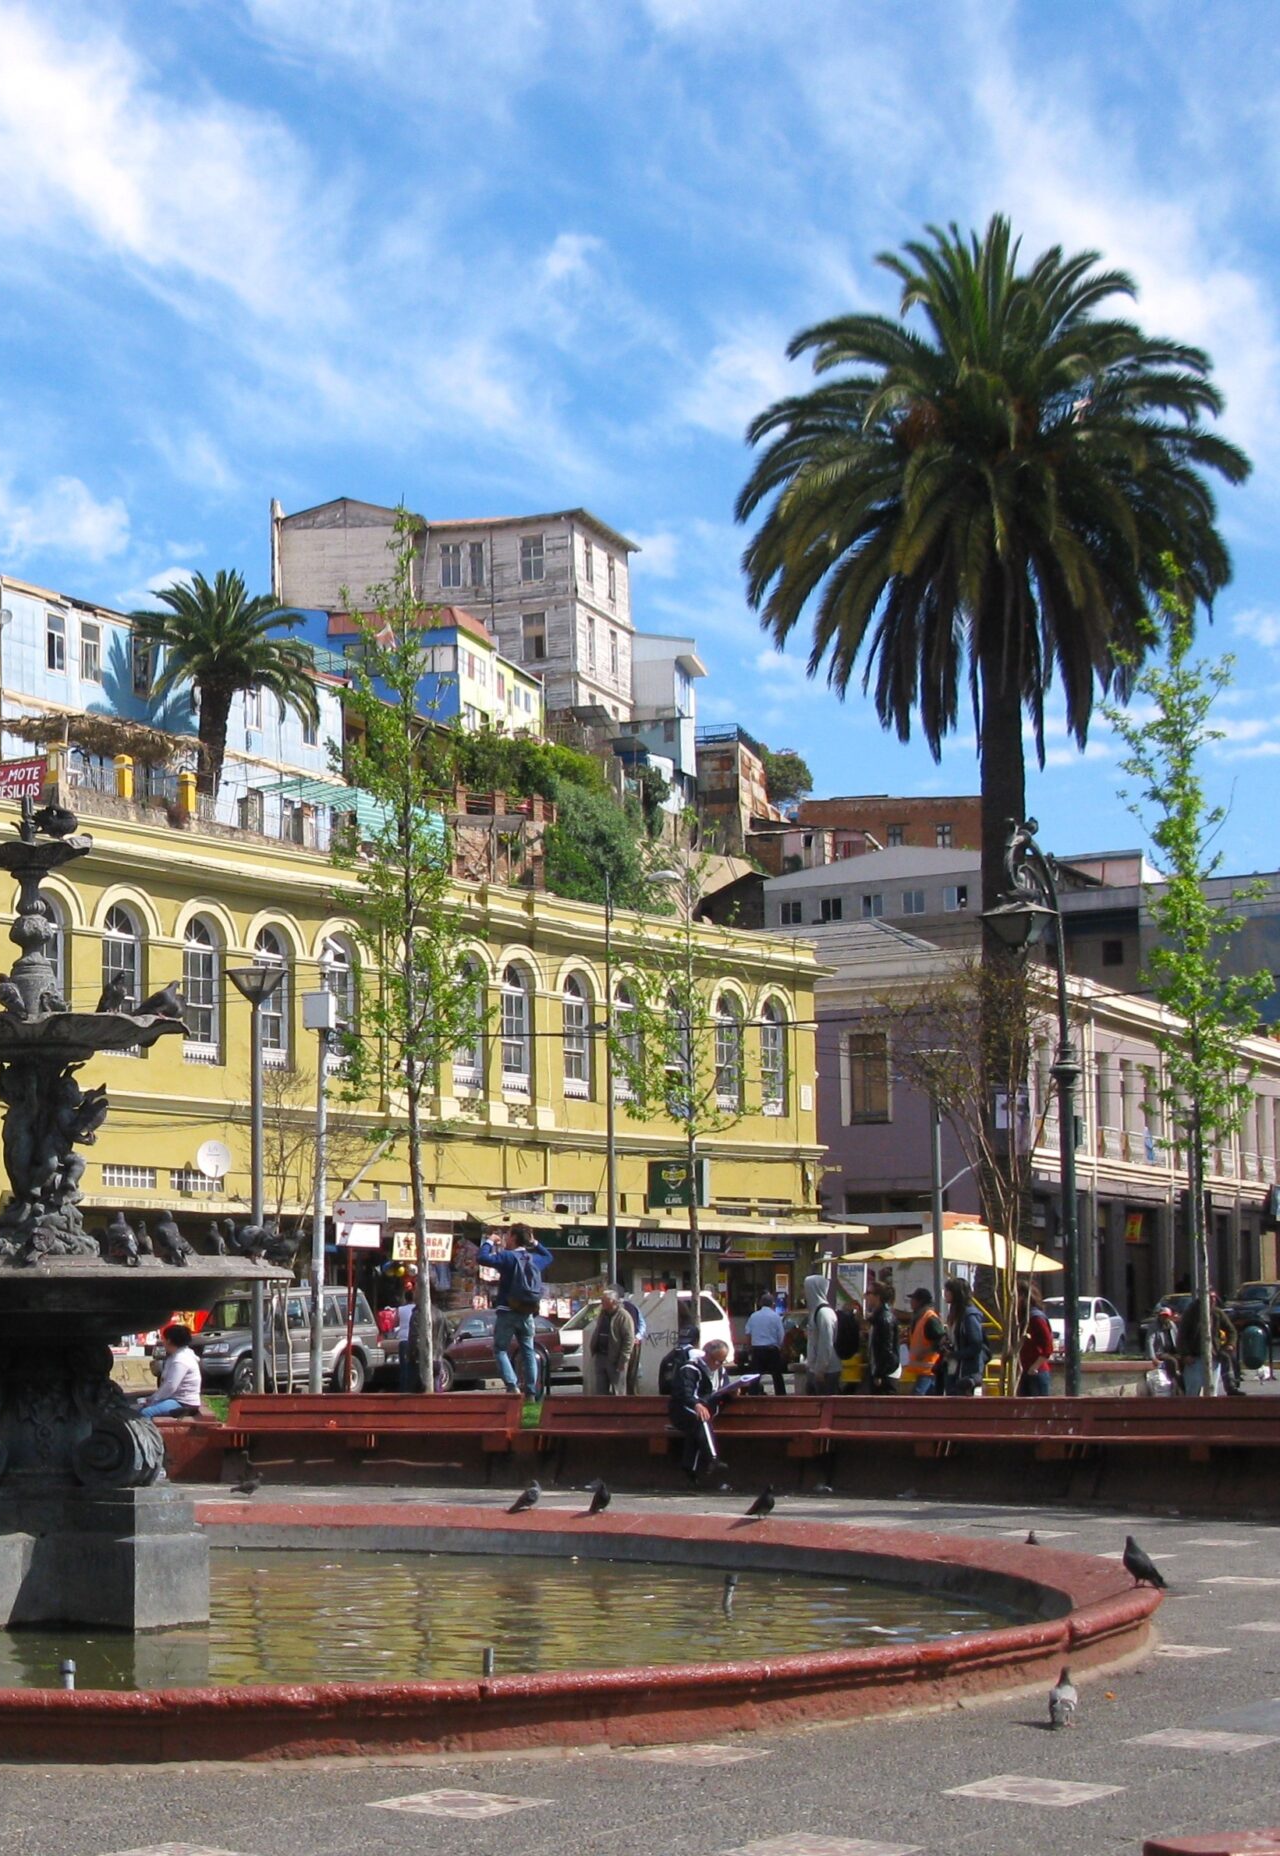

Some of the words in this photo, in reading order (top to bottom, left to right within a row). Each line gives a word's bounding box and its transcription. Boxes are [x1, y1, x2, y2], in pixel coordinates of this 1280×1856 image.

[7, 766, 41, 782] MOTE
[567, 1235, 590, 1247] CLAVE
[636, 1232, 682, 1248] PELUQUERIA
[704, 1235, 721, 1249] LUIS
